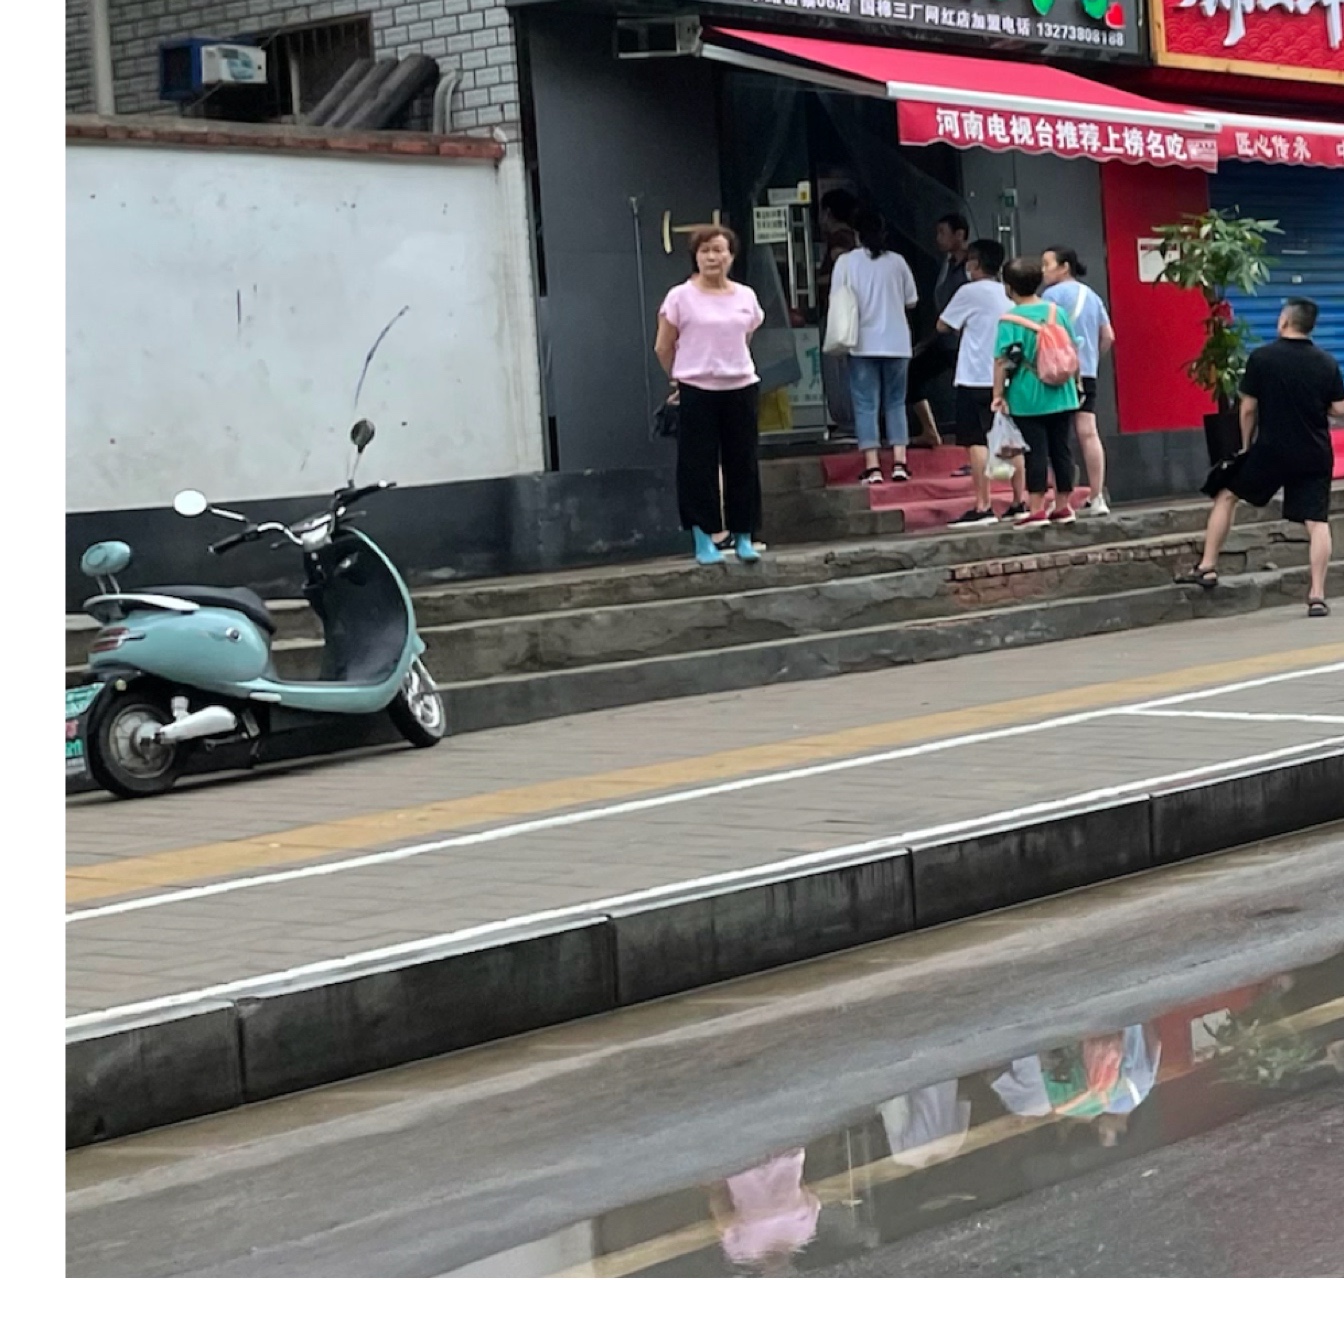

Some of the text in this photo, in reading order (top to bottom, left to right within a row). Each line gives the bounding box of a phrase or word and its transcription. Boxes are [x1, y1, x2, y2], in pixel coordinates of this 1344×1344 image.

[935, 107, 1188, 161] 河南电视台推荐上榜名吃
